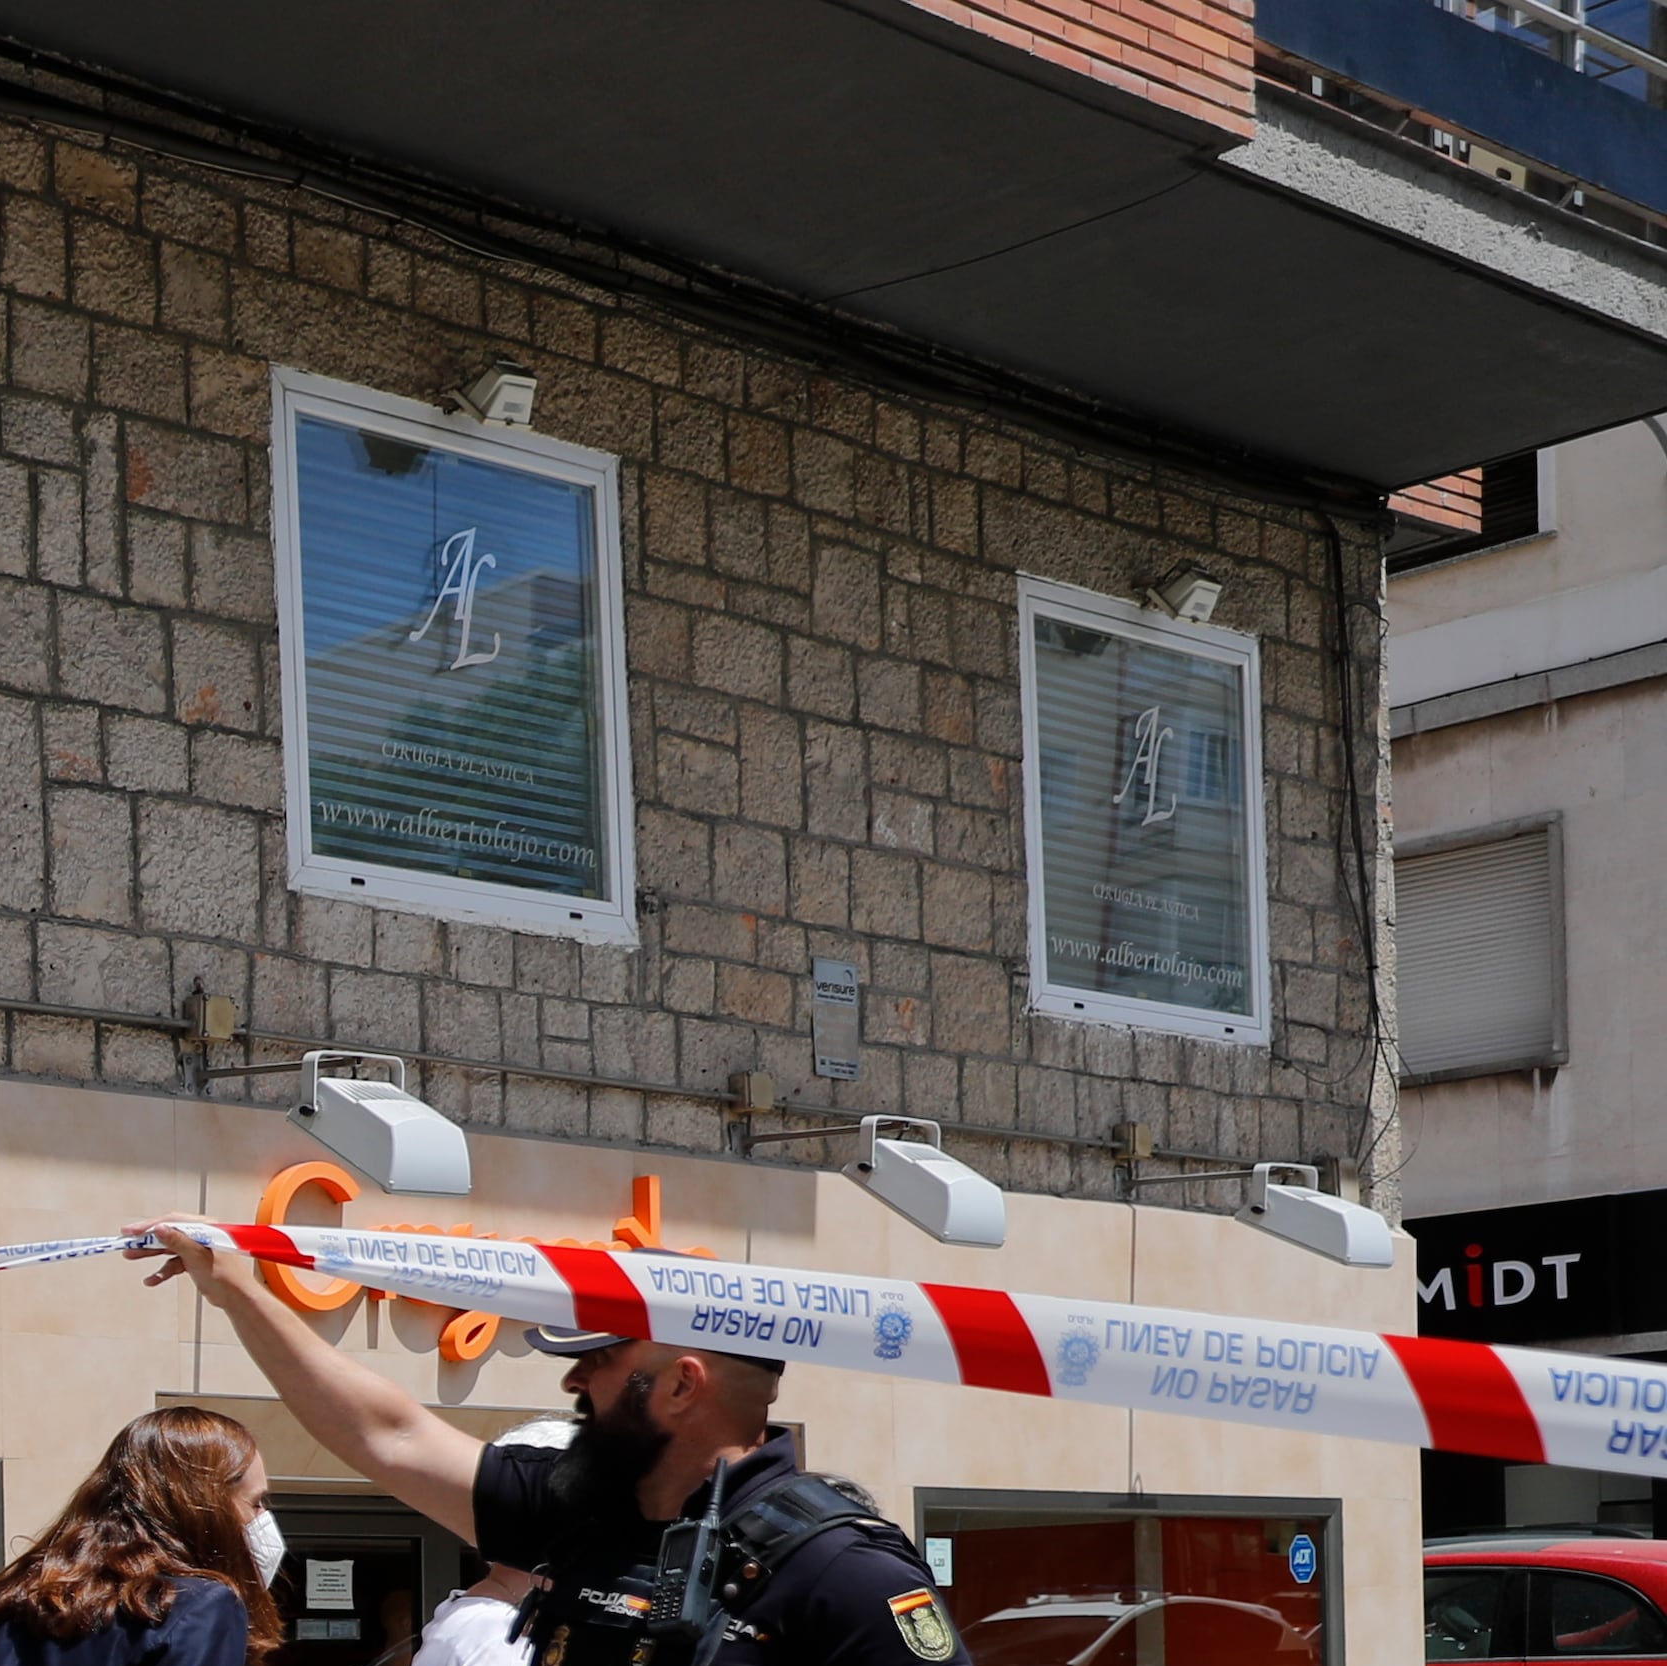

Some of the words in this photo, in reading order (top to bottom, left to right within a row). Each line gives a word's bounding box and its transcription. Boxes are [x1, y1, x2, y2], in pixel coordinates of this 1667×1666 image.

[317, 800, 597, 869] www.albertolajo.com
[1050, 935, 1244, 988] www.albertolajo.com
[647, 1265, 744, 1301] POLICIA
[751, 1276, 787, 1307] DE
[793, 1281, 870, 1318] LINEA
[690, 1303, 777, 1341] PASAR
[781, 1316, 823, 1348] NO
